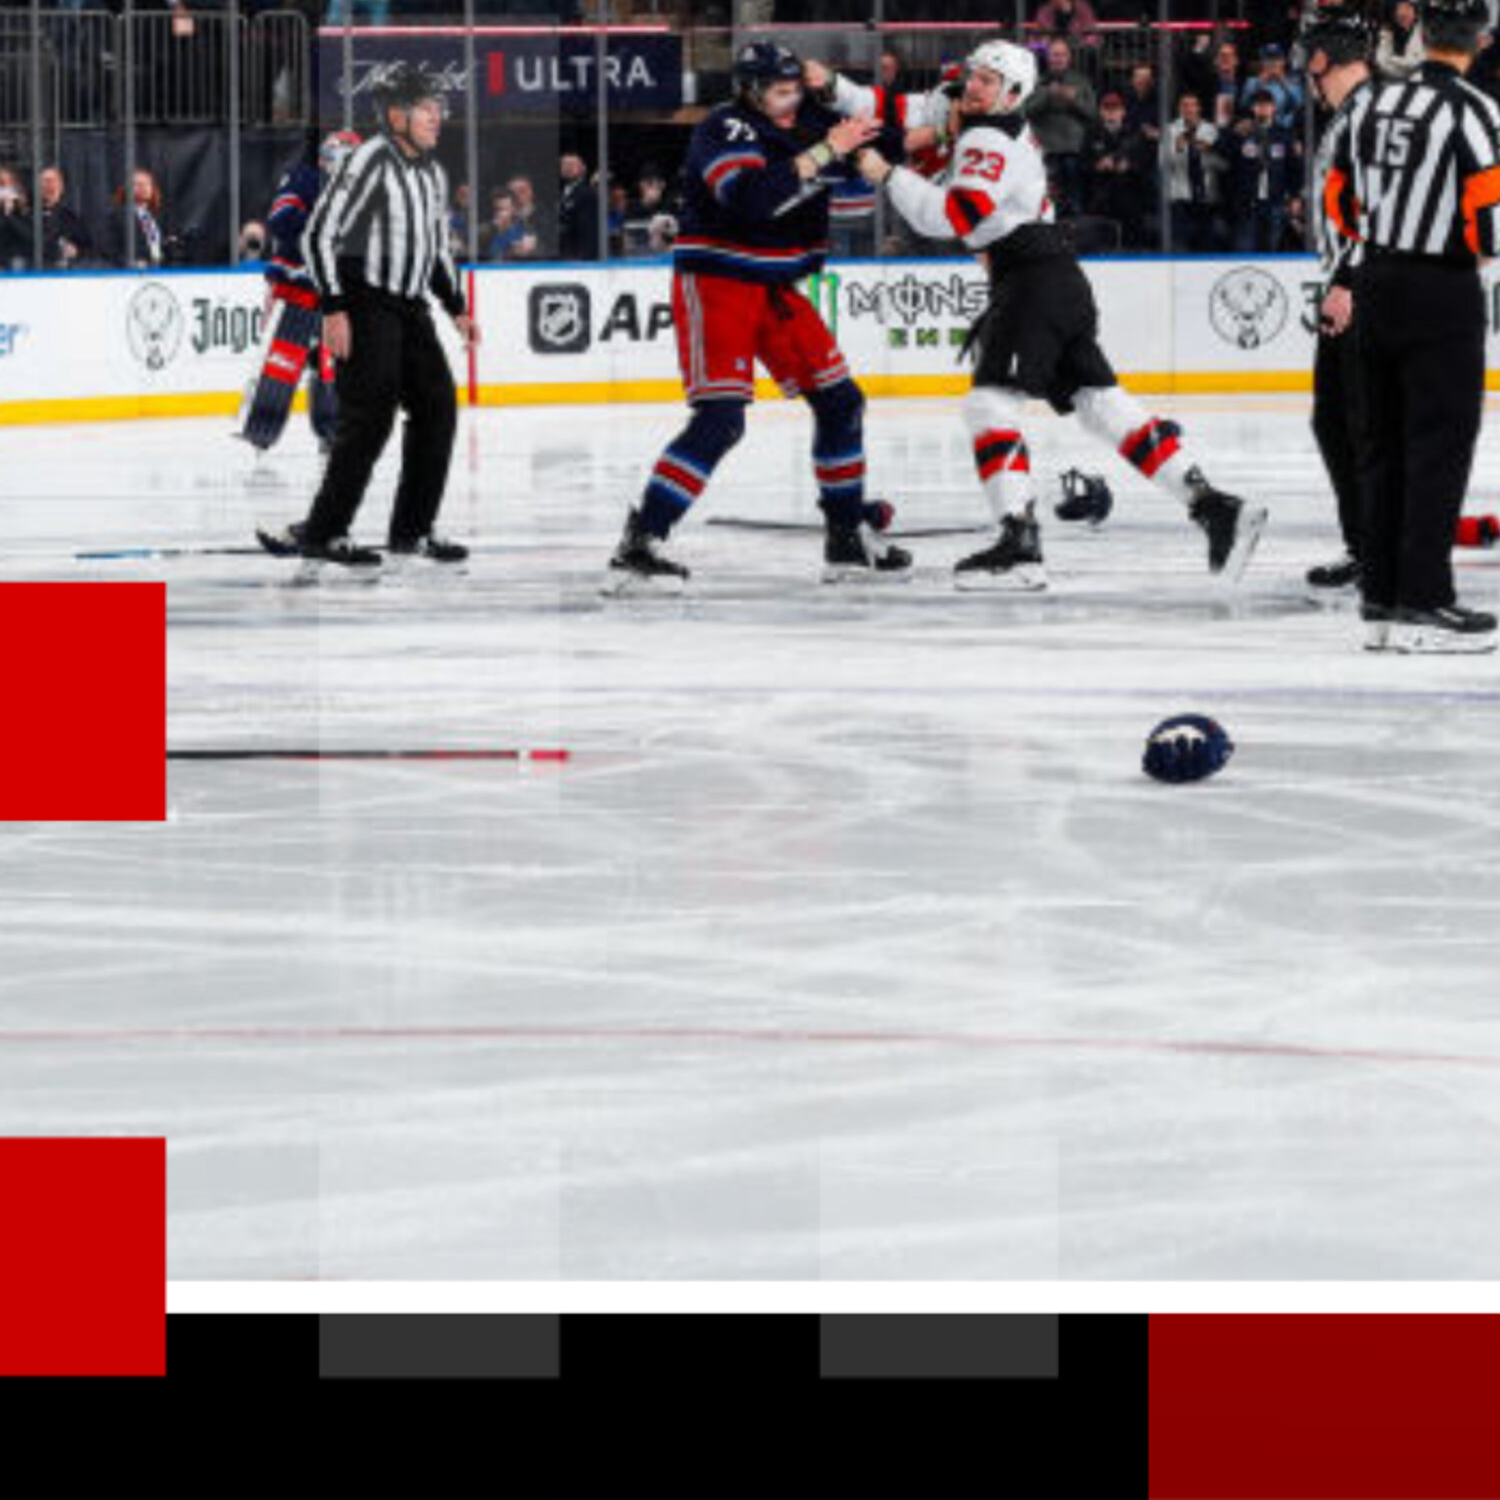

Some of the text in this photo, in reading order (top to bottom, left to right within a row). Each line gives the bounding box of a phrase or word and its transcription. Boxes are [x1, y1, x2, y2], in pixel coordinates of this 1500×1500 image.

[513, 54, 656, 92] ULTRA
[1373, 117, 1411, 166] 15
[958, 149, 1006, 183] 23
[847, 274, 992, 324] MONS
